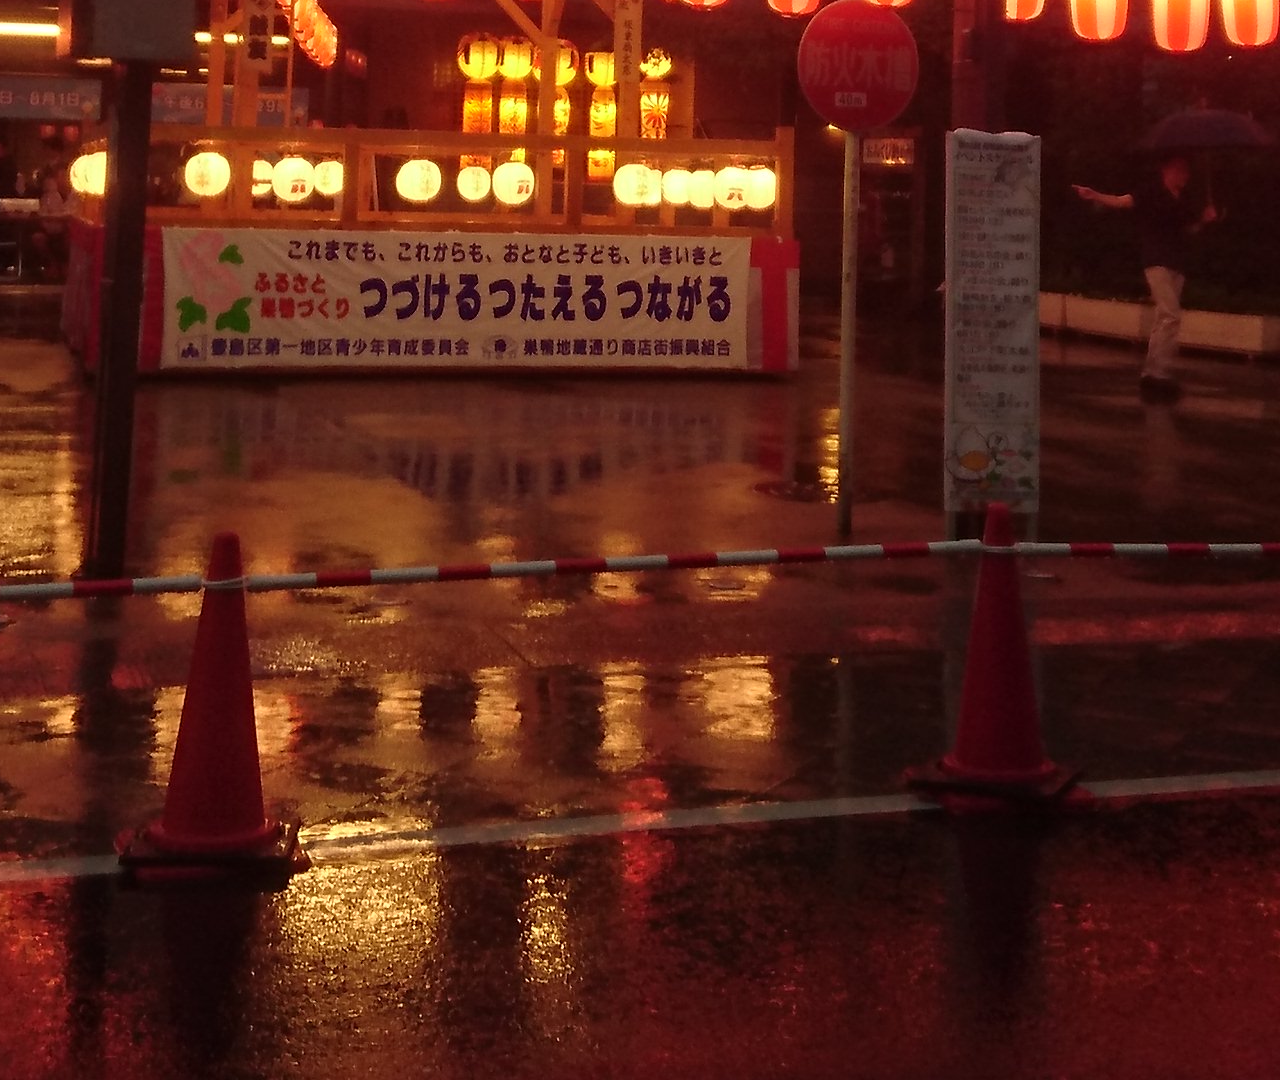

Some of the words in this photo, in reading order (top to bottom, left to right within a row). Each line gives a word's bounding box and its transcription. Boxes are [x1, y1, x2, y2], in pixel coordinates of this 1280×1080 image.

[255, 272, 327, 294] ふるさと
[260, 296, 351, 320] 巣鴨づくり
[210, 336, 471, 357] 豊島区第一地区青少年育成委員会
[523, 337, 732, 358] 巣鴨地蔵通り商店街振興組合
